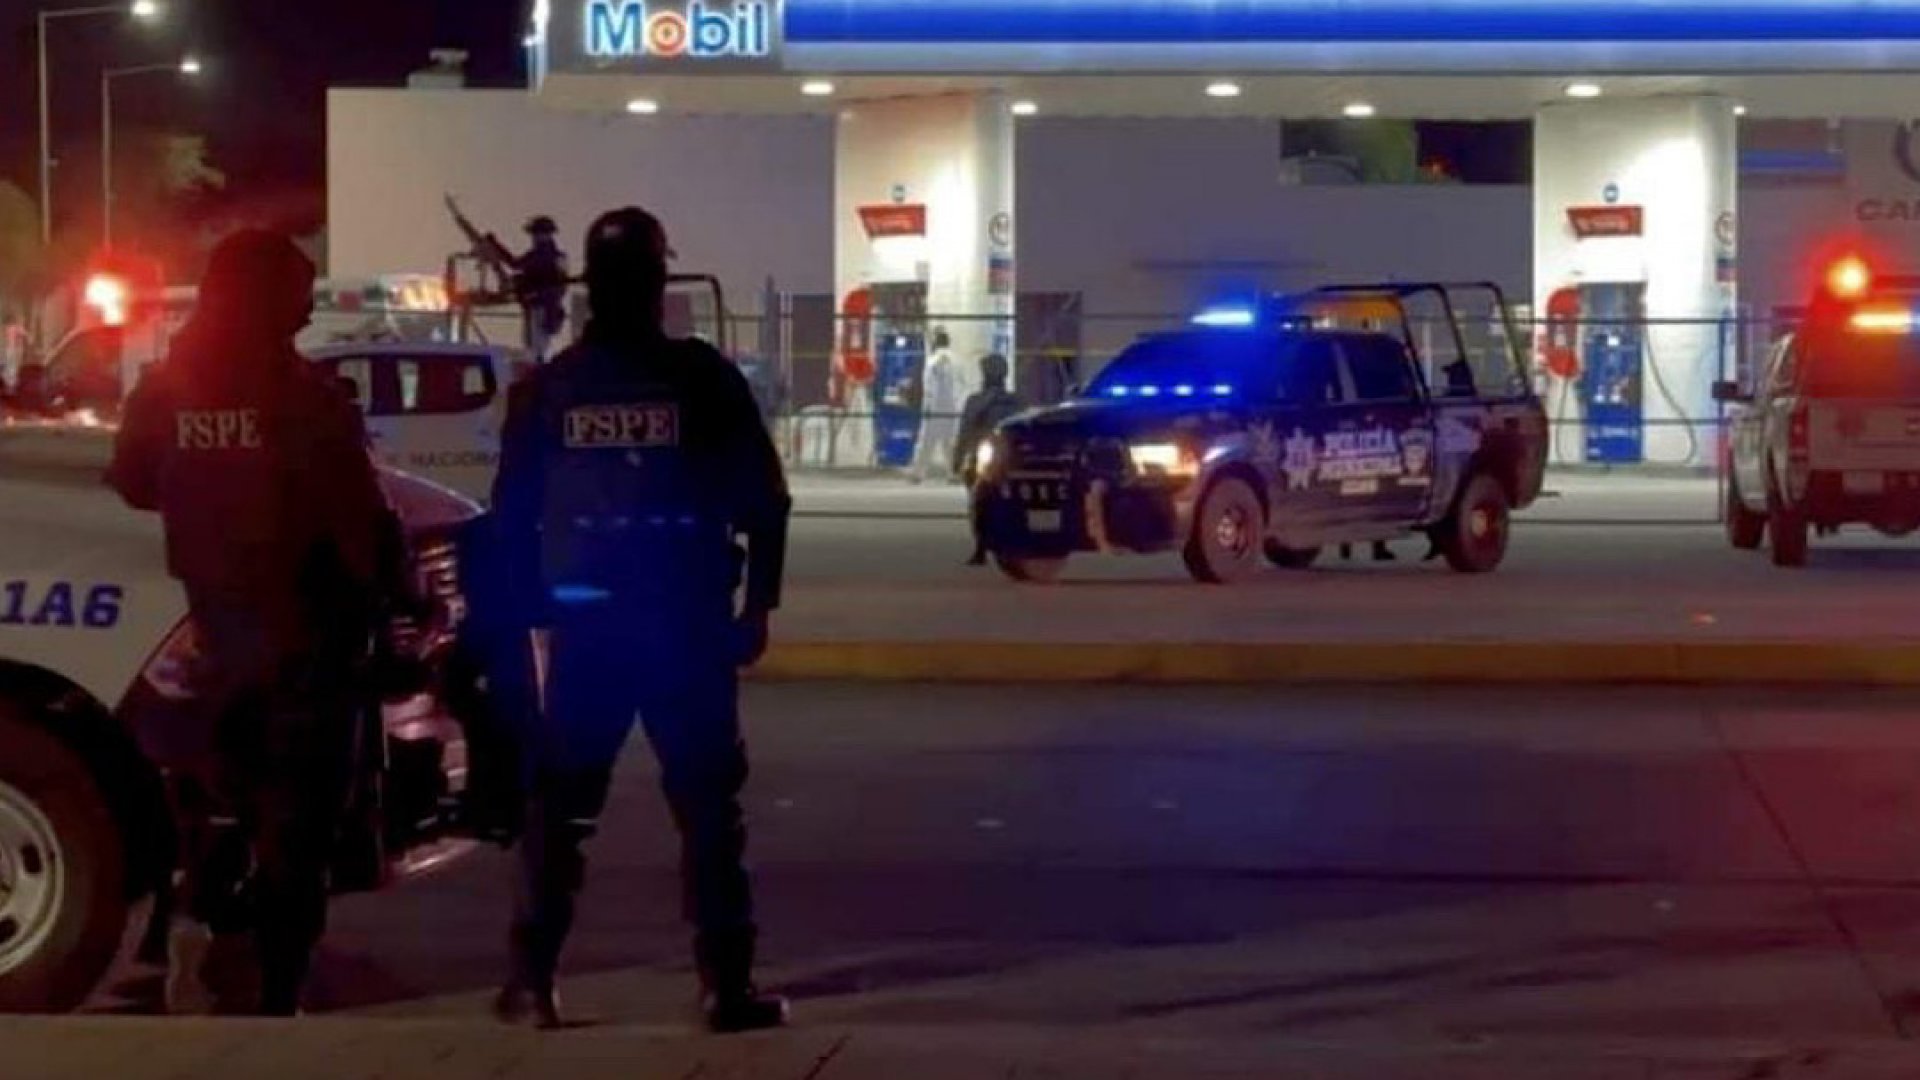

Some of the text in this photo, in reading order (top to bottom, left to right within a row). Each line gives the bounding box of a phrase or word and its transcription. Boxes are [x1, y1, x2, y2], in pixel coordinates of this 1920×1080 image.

[588, 1, 765, 54] Mobil
[177, 409, 262, 450] FSPE
[572, 409, 671, 442] FSPE
[0, 579, 124, 628] 1A6
